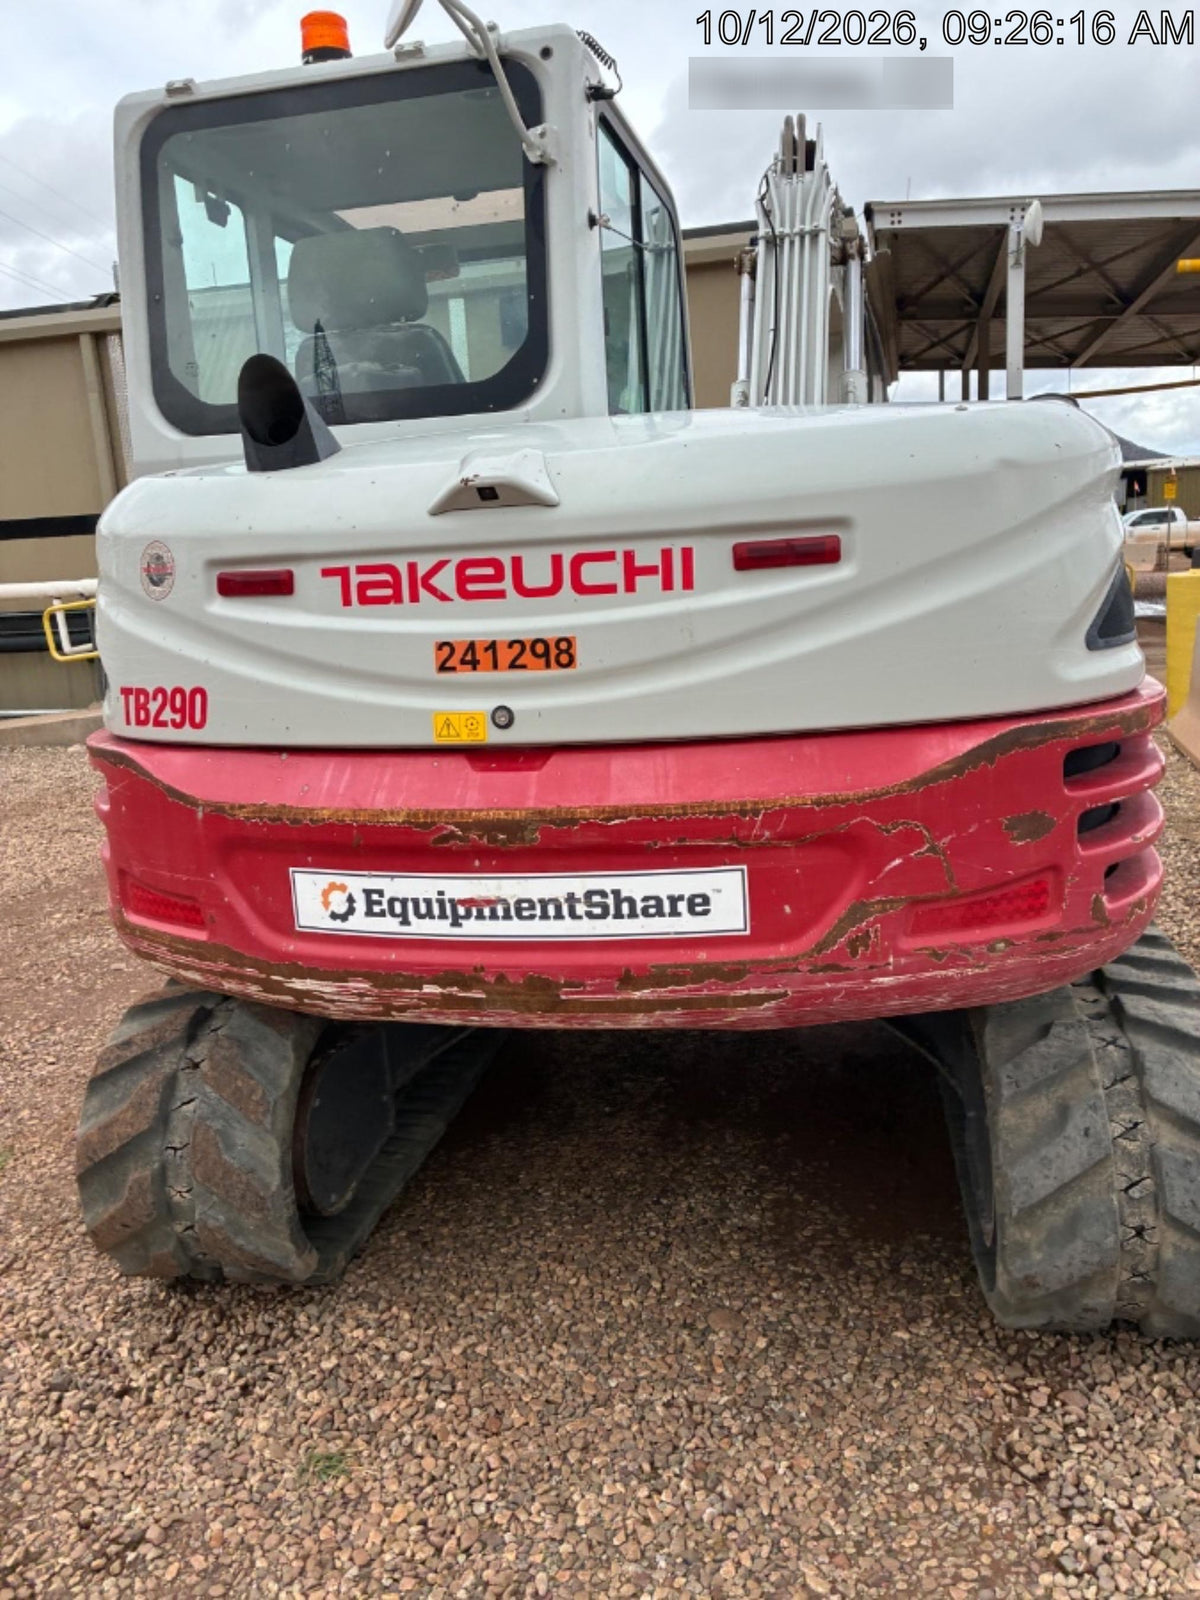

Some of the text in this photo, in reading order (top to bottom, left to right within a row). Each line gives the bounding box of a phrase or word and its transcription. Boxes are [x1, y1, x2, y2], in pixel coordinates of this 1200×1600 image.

[320, 546, 694, 607] TAKEUCHI
[436, 636, 575, 672] 241298
[120, 686, 208, 730] TB290
[362, 887, 711, 928] EquipmentShare
